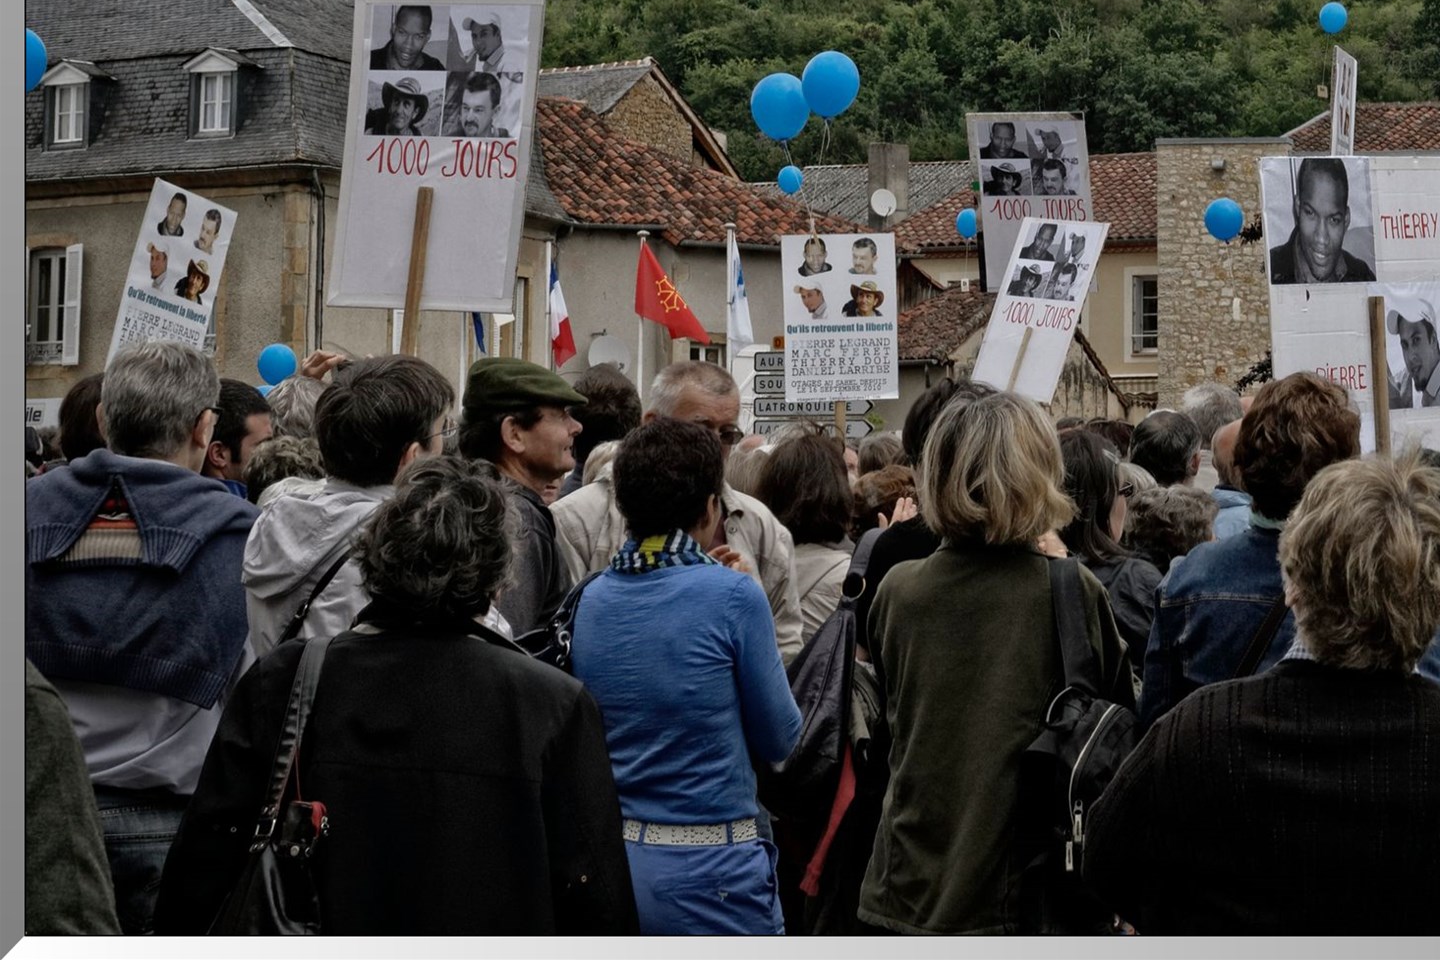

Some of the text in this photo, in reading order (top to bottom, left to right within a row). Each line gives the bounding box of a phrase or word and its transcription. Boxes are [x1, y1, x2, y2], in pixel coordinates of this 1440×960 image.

[367, 138, 518, 179] 1000 JOURS
[990, 198, 1087, 222] 1000 JOURS
[1380, 209, 1438, 239] THIERRY
[127, 286, 207, 325] Qu'ils retrouvent la liberté
[1002, 300, 1076, 331] 1000 JOURS
[161, 318, 201, 342] LEGRAND
[786, 322, 894, 334] Qu'ils retrouvent la liberté
[791, 337, 892, 349] PIERRE LEGRAND
[791, 347, 892, 358] MARC FERET
[760, 357, 784, 367] AUR
[791, 356, 892, 367] THIERRY DOL
[791, 364, 891, 377] DANIEL LARRIBE
[759, 379, 783, 389] SOU
[791, 377, 888, 388] OTAGES AU SAHEL DEPUIS
[796, 386, 806, 394] LE
[820, 385, 861, 393] SEPTEMBRE
[863, 384, 882, 392] 2010
